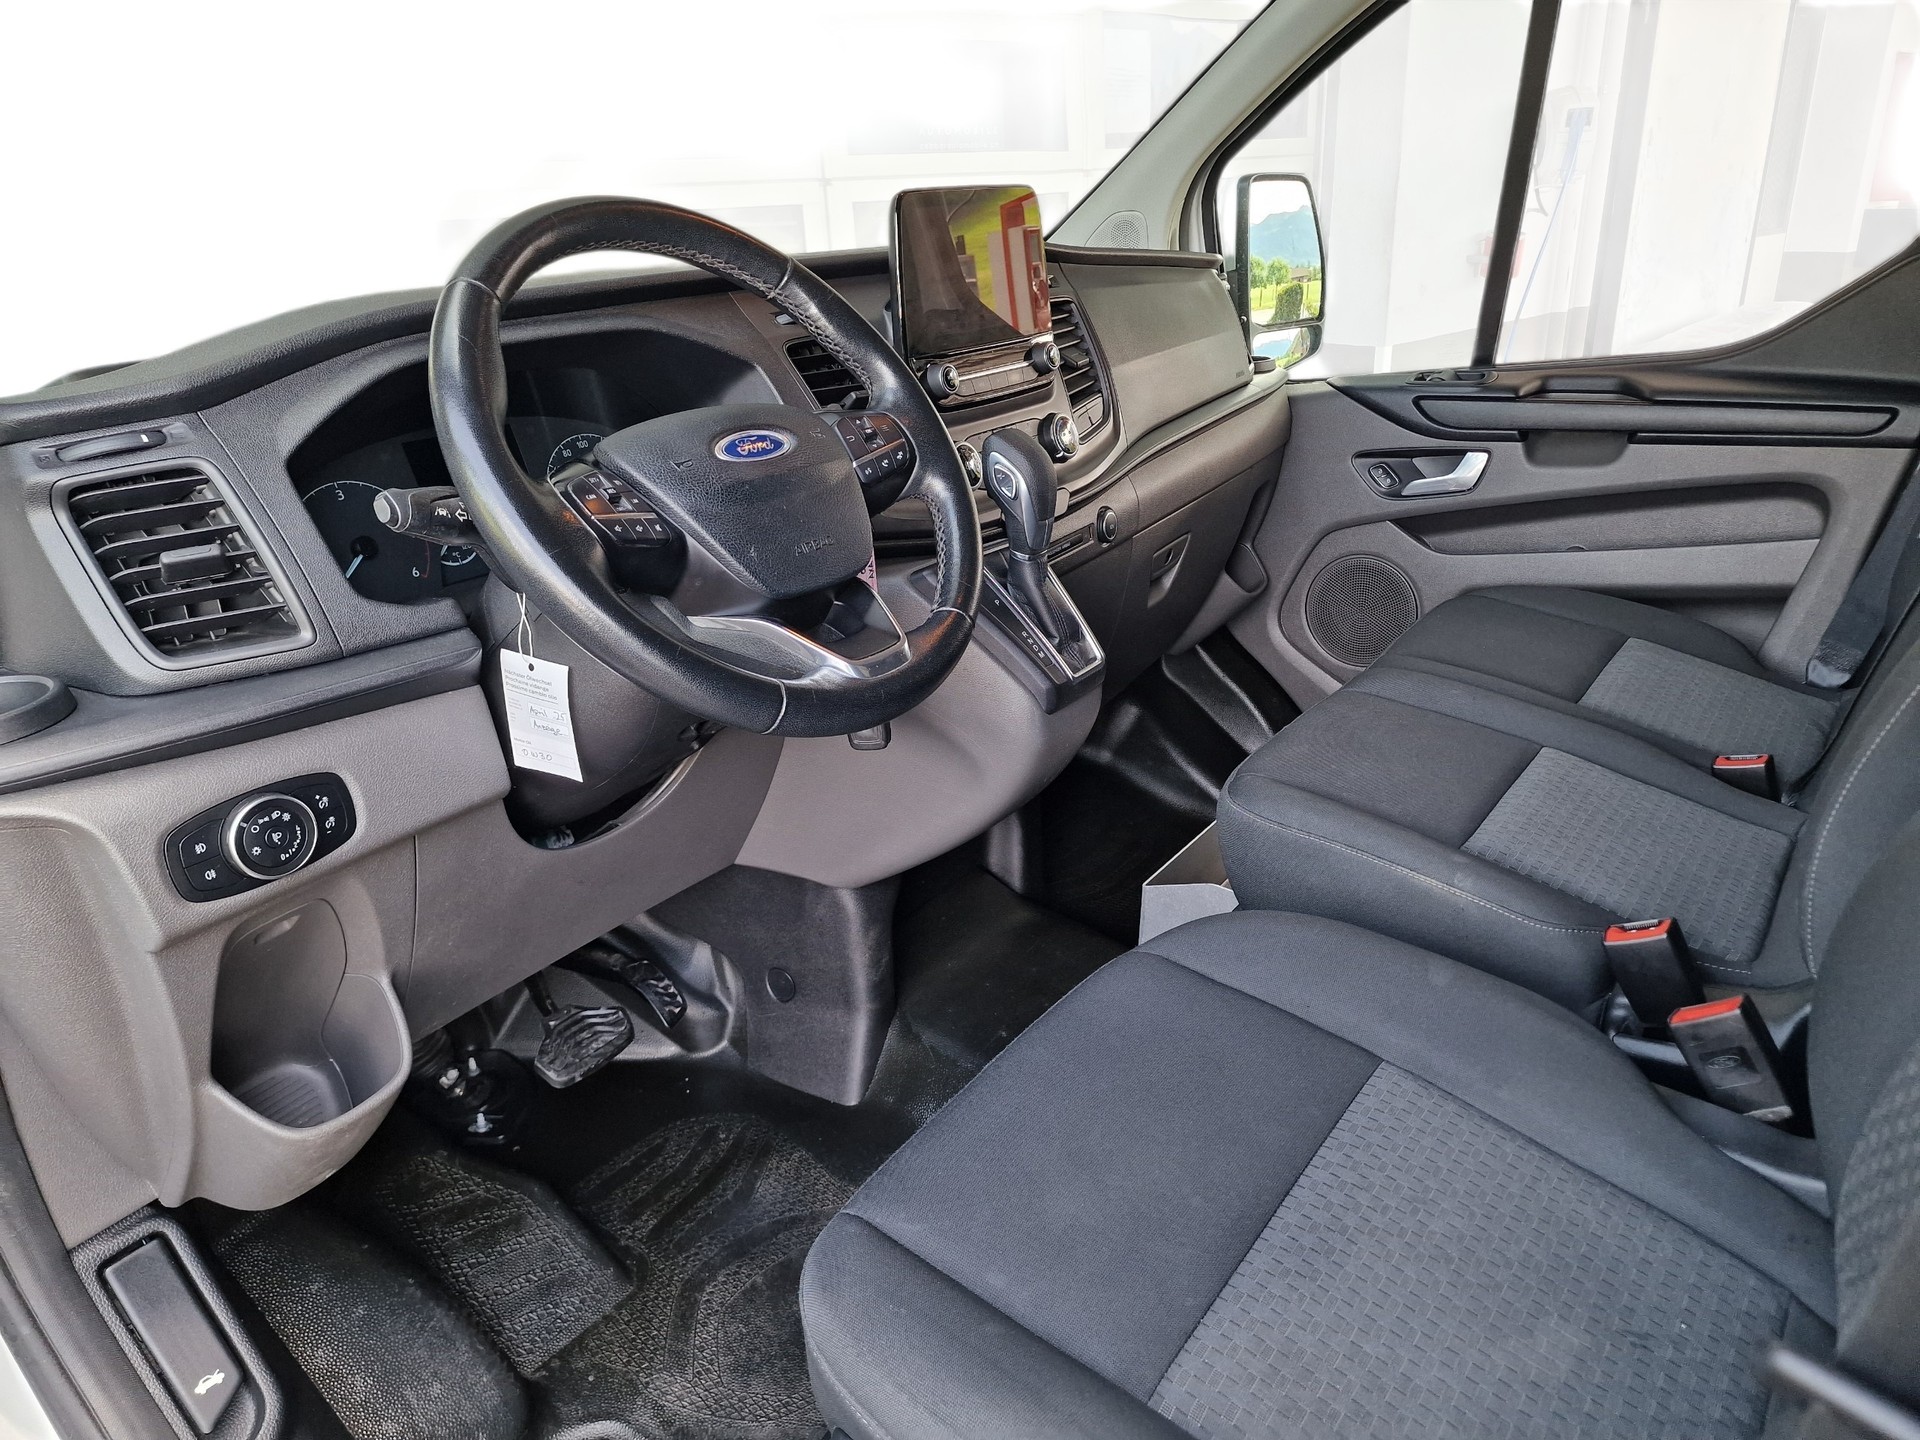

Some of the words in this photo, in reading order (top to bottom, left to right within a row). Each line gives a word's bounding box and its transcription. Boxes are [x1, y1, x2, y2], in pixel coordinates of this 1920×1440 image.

[576, 440, 589, 448] 100
[736, 436, 774, 455] Ford
[562, 449, 572, 457] 80
[335, 490, 345, 500] 3
[794, 536, 834, 556] AIRBAG
[412, 567, 420, 577] 6
[530, 705, 548, 718] April
